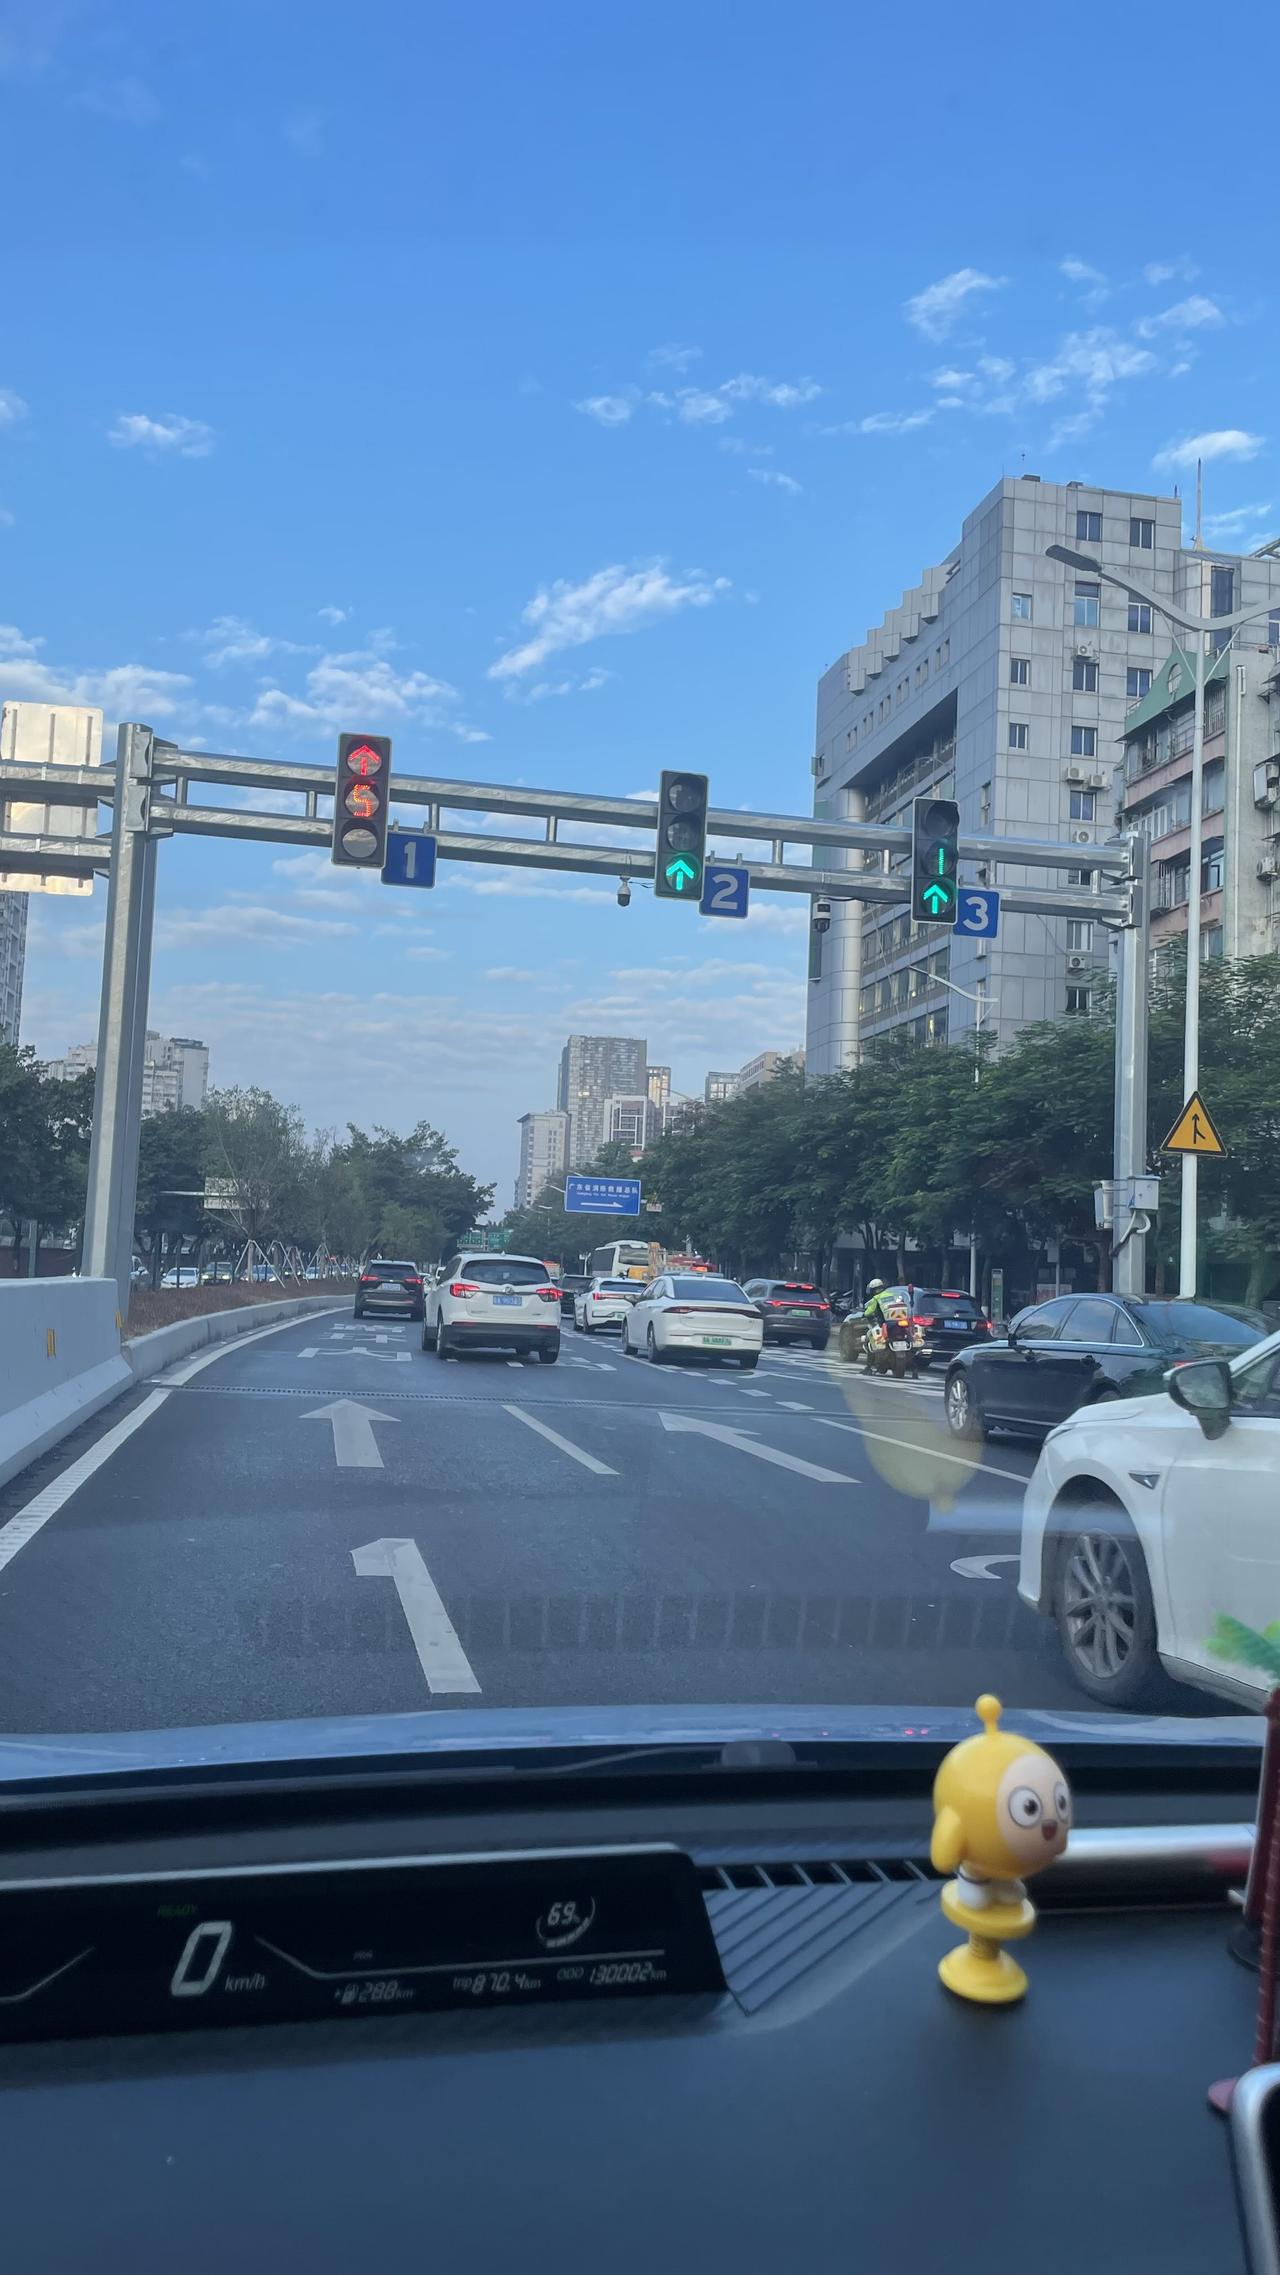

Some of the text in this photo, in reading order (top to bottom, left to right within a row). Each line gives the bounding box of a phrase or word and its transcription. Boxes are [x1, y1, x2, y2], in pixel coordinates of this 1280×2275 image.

[352, 783, 371, 818] 5
[404, 841, 417, 879] 1
[711, 873, 738, 910] 2
[962, 896, 989, 932] 3
[170, 1920, 267, 1997] 0 km/h
